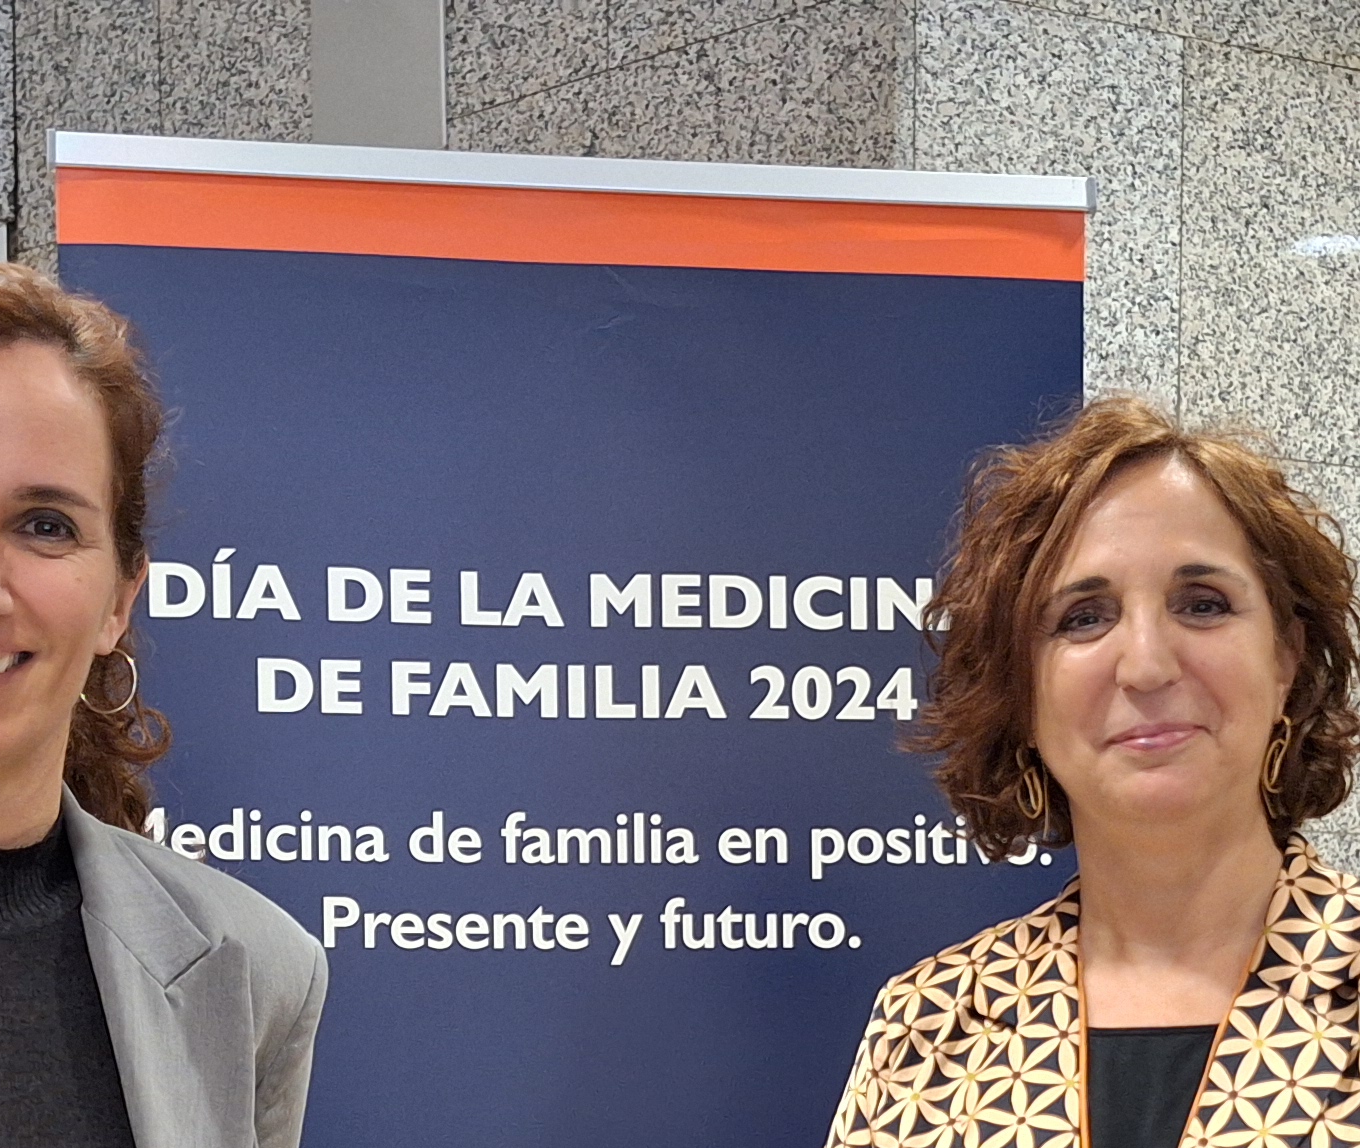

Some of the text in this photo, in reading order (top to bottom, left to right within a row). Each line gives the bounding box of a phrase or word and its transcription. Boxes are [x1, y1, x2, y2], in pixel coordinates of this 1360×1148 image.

[148, 547, 952, 631] DÍA DE LA MEDICIN
[256, 657, 919, 721] DE FAMILIA 2024
[408, 810, 482, 864] de
[500, 811, 700, 864] familia
[718, 827, 788, 864] en
[321, 896, 862, 966] Presente y futuro.
